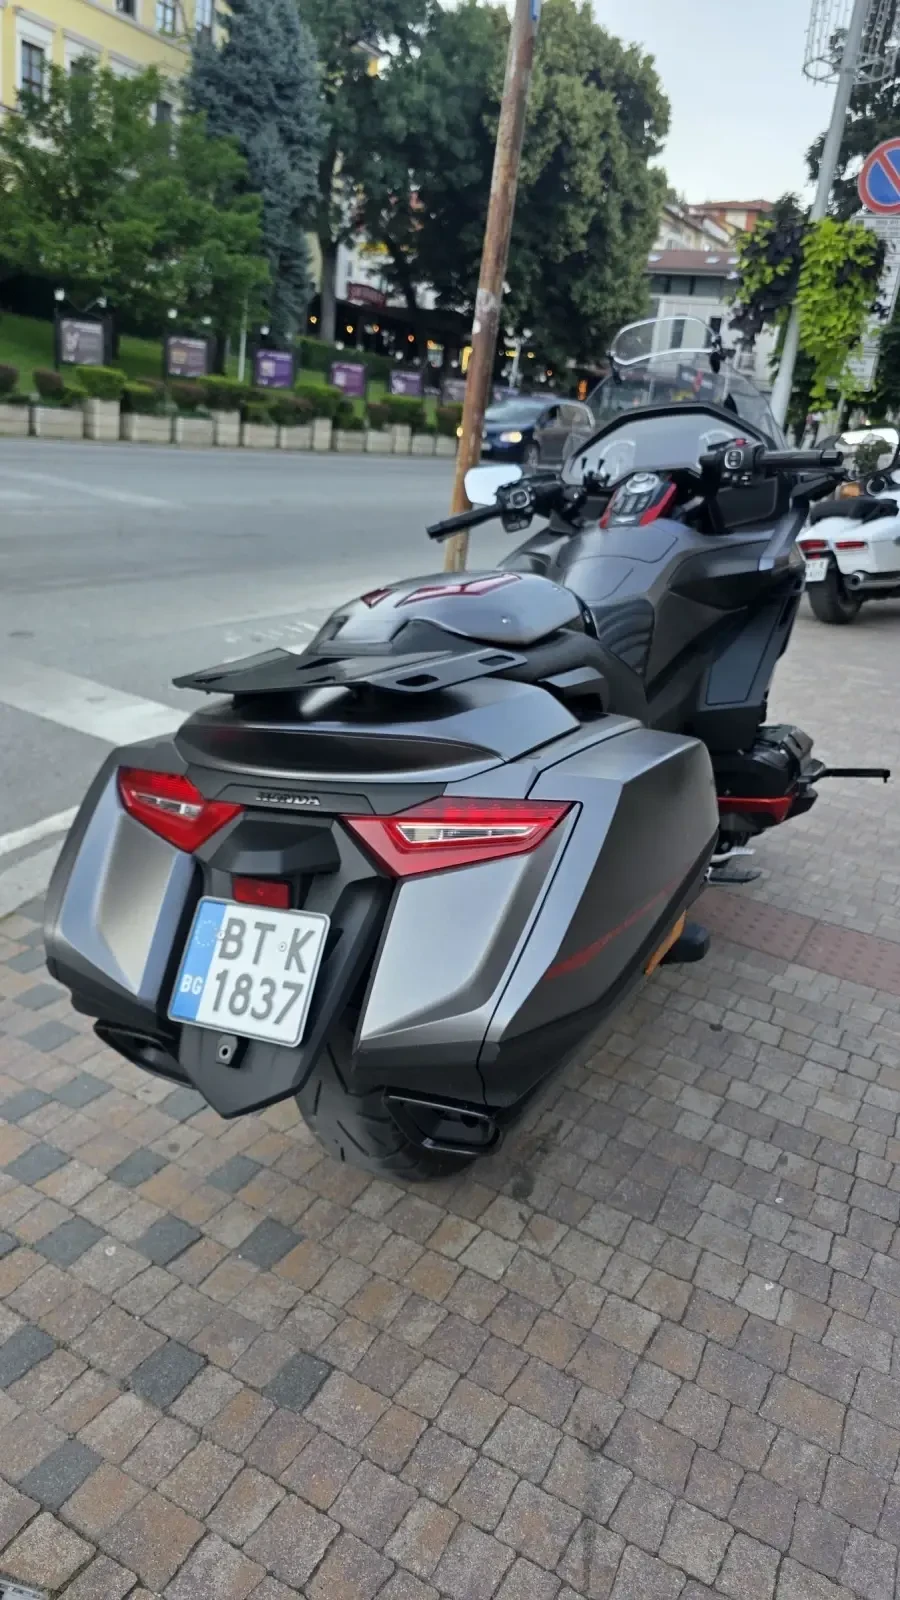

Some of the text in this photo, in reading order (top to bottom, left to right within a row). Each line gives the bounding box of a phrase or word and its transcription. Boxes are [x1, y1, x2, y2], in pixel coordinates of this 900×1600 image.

[256, 792, 320, 806] HONDA
[218, 917, 316, 974] BT K
[180, 973, 203, 995] BG
[212, 969, 304, 1026] 1837
